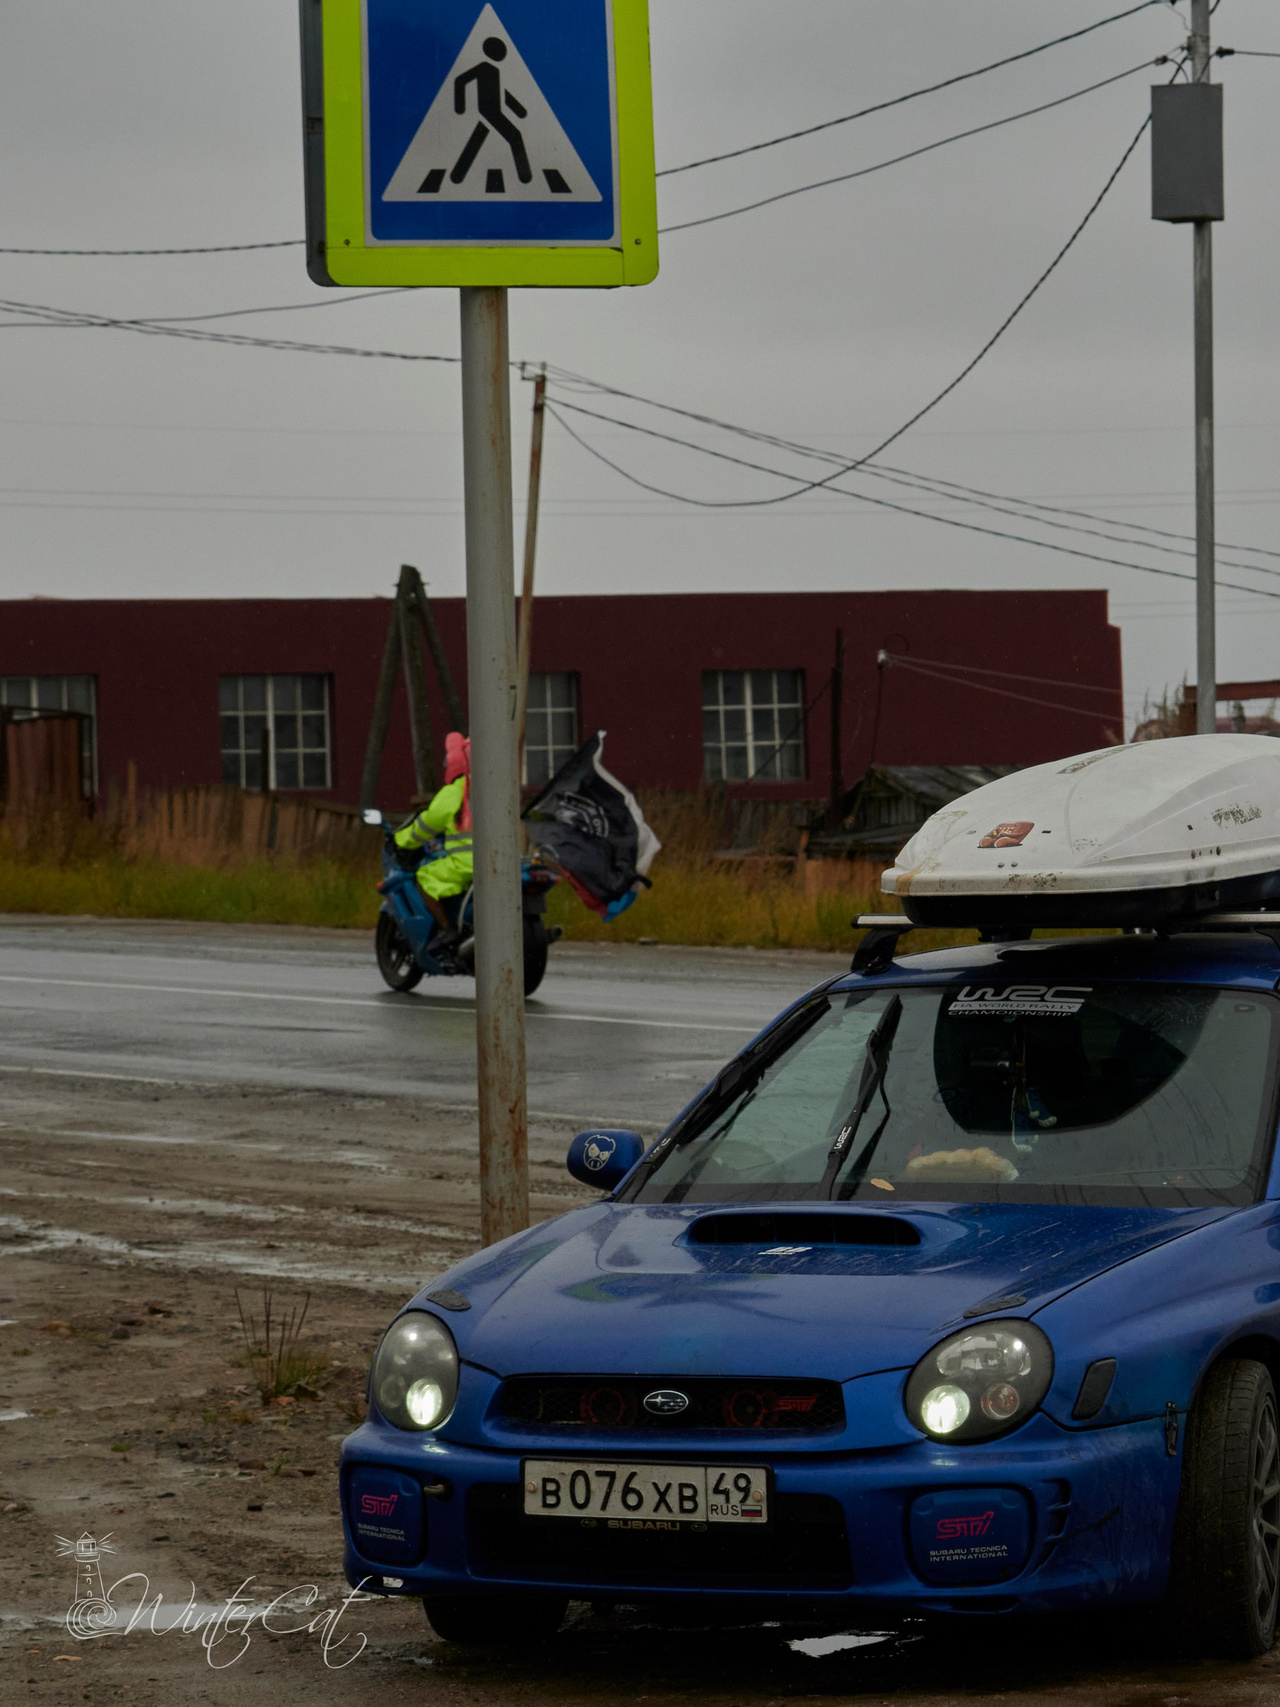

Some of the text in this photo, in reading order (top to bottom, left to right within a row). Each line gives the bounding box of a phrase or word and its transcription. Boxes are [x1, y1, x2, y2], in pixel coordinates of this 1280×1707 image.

[956, 985, 1093, 1003] WRC
[712, 1472, 752, 1504] 49
[710, 1504, 740, 1517] RUS
[357, 1522, 405, 1535] SUBARU TECNICA
[607, 1519, 681, 1531] SUBARU
[358, 1529, 406, 1541] INTERNATIONAL
[929, 1544, 1008, 1556] SUBARU TECNICA
[930, 1552, 1009, 1562] INTERNATIONAL
